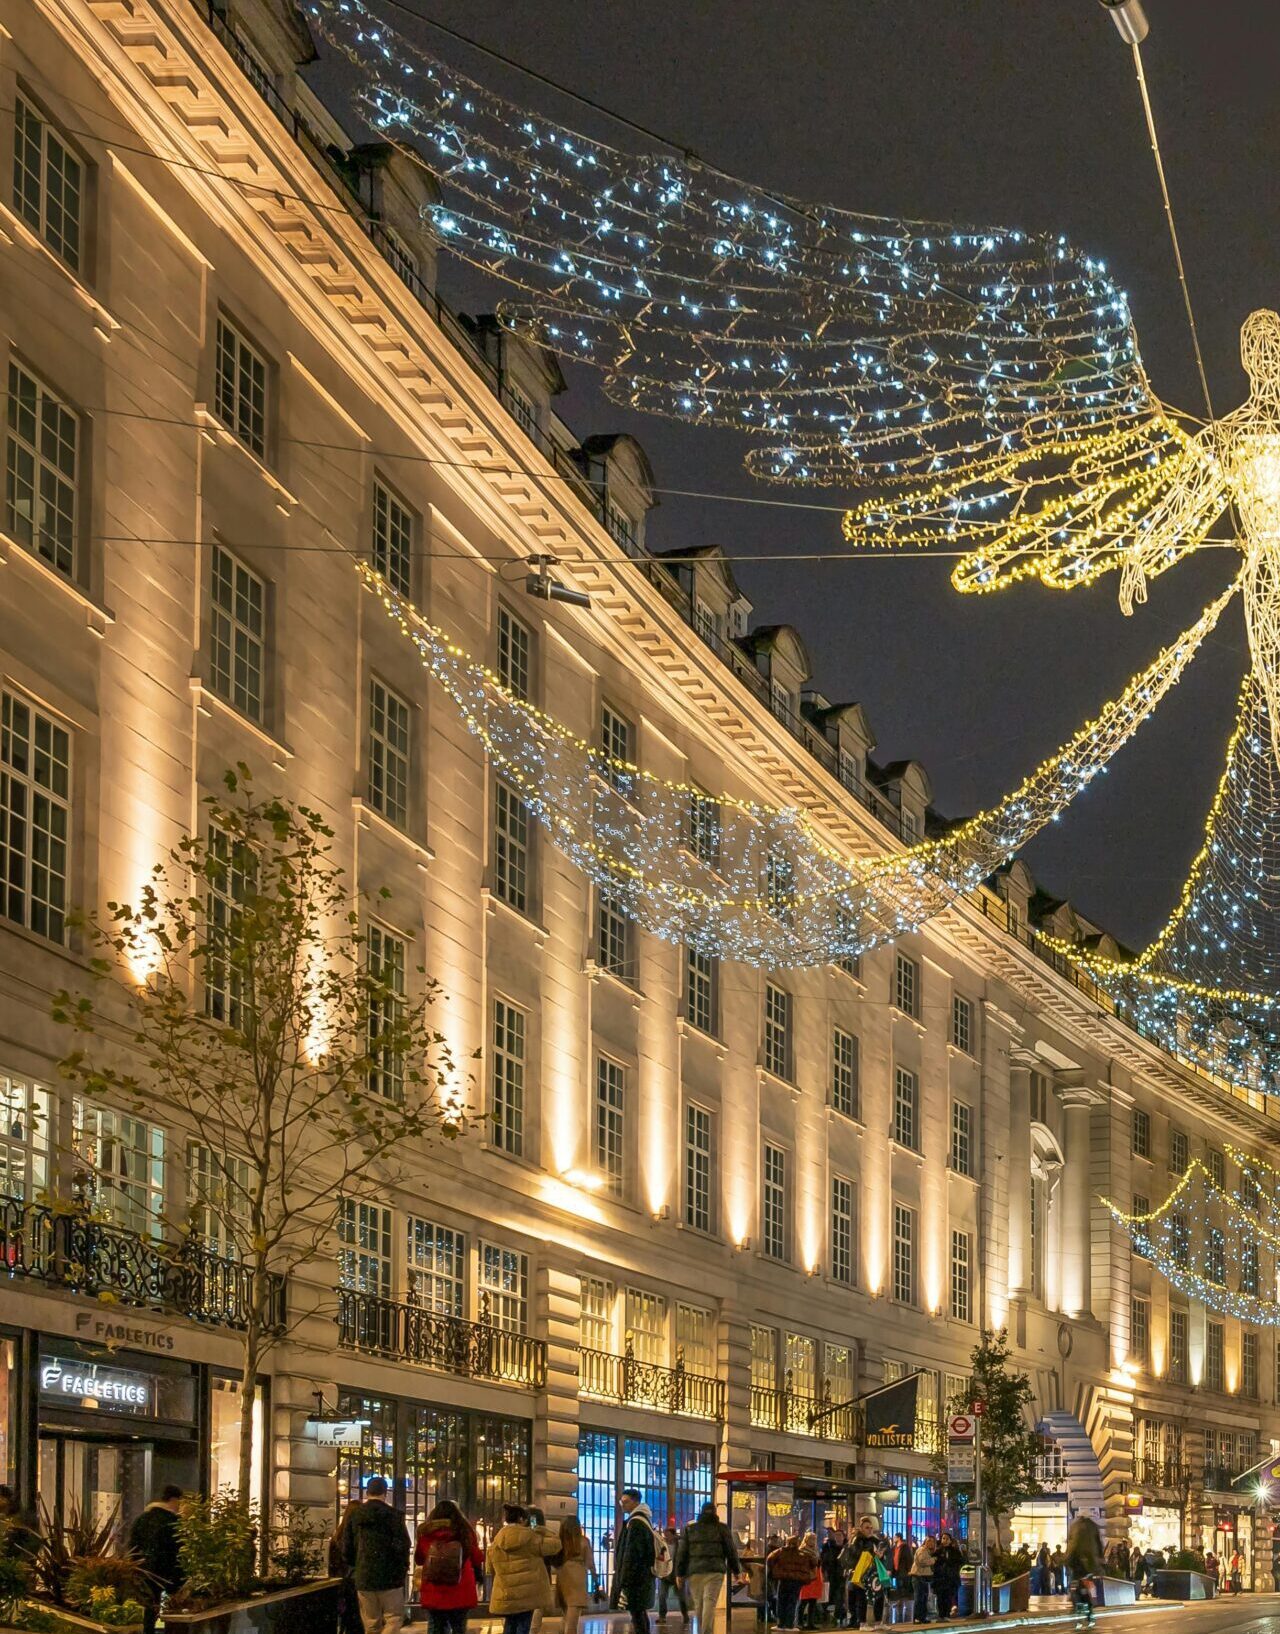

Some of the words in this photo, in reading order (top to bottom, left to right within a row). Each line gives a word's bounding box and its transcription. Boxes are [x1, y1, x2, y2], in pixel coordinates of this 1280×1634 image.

[95, 1321, 174, 1350] FABLETICS
[61, 1375, 146, 1403] FABLETICS
[974, 1402, 982, 1413] E
